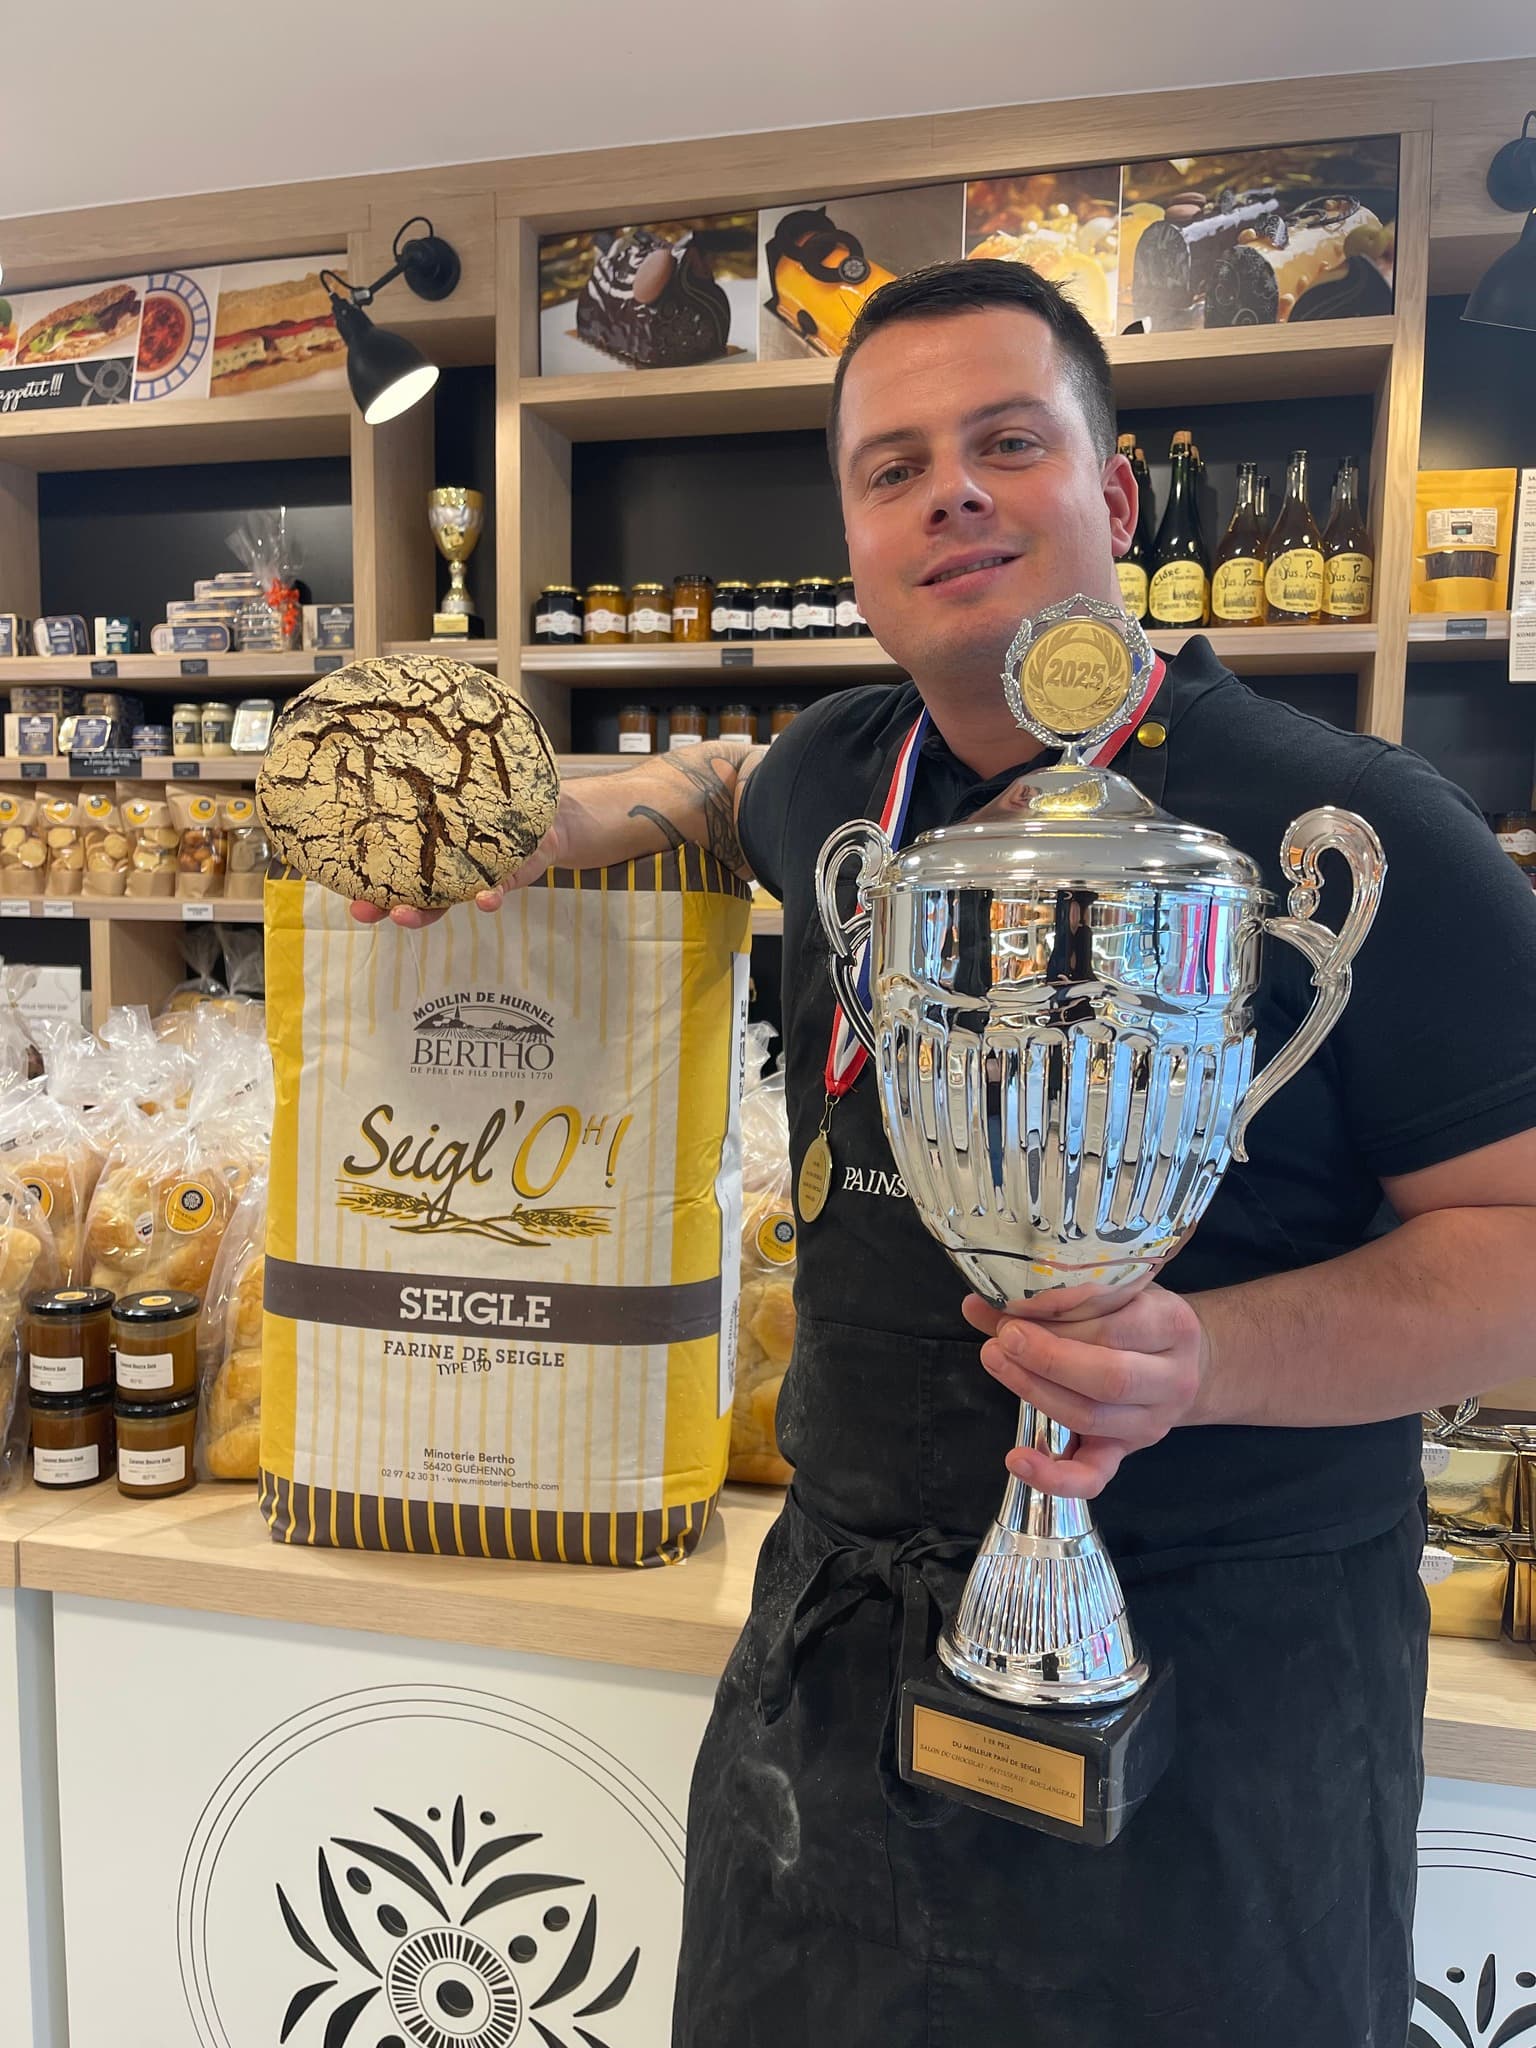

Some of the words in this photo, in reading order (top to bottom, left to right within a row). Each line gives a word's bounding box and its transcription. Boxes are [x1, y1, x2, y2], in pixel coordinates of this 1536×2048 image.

[1046, 658, 1106, 690] 2025
[413, 992, 471, 1021] MOULIN
[476, 992, 496, 1003] DE
[500, 994, 556, 1028] HURNEL
[410, 1038, 554, 1071] BERTHO
[410, 1066, 422, 1074] DE
[468, 1069, 488, 1078] FILS
[492, 1070, 526, 1080] DEPUIS
[530, 1072, 553, 1081] 1770
[842, 1166, 908, 1198] PAINS
[400, 1286, 551, 1329] SEIGLE
[384, 1340, 454, 1360] FARINE
[462, 1346, 488, 1362] DE
[495, 1349, 565, 1367] SEIGLE
[436, 1361, 469, 1376] TYPE
[423, 1461, 452, 1472] 56420
[454, 1462, 516, 1478] GUÉHENNO
[424, 1448, 475, 1462] Minoterie
[478, 1452, 515, 1465] Bertho
[381, 1469, 391, 1477] 02
[393, 1470, 404, 1479] 97
[405, 1471, 416, 1479] 42
[417, 1472, 428, 1481] 30
[429, 1473, 439, 1482] 31
[447, 1477, 560, 1491] www.minoterie-bertho.com
[920, 1744, 940, 1754] SALON
[951, 1753, 985, 1769] CHOCOLAT
[952, 1740, 962, 1749] DU
[963, 1744, 993, 1759] MEILLEUR
[993, 1754, 1009, 1764] PAIN
[1010, 1759, 1019, 1767] DE
[1020, 1762, 1041, 1774] SEIGLE
